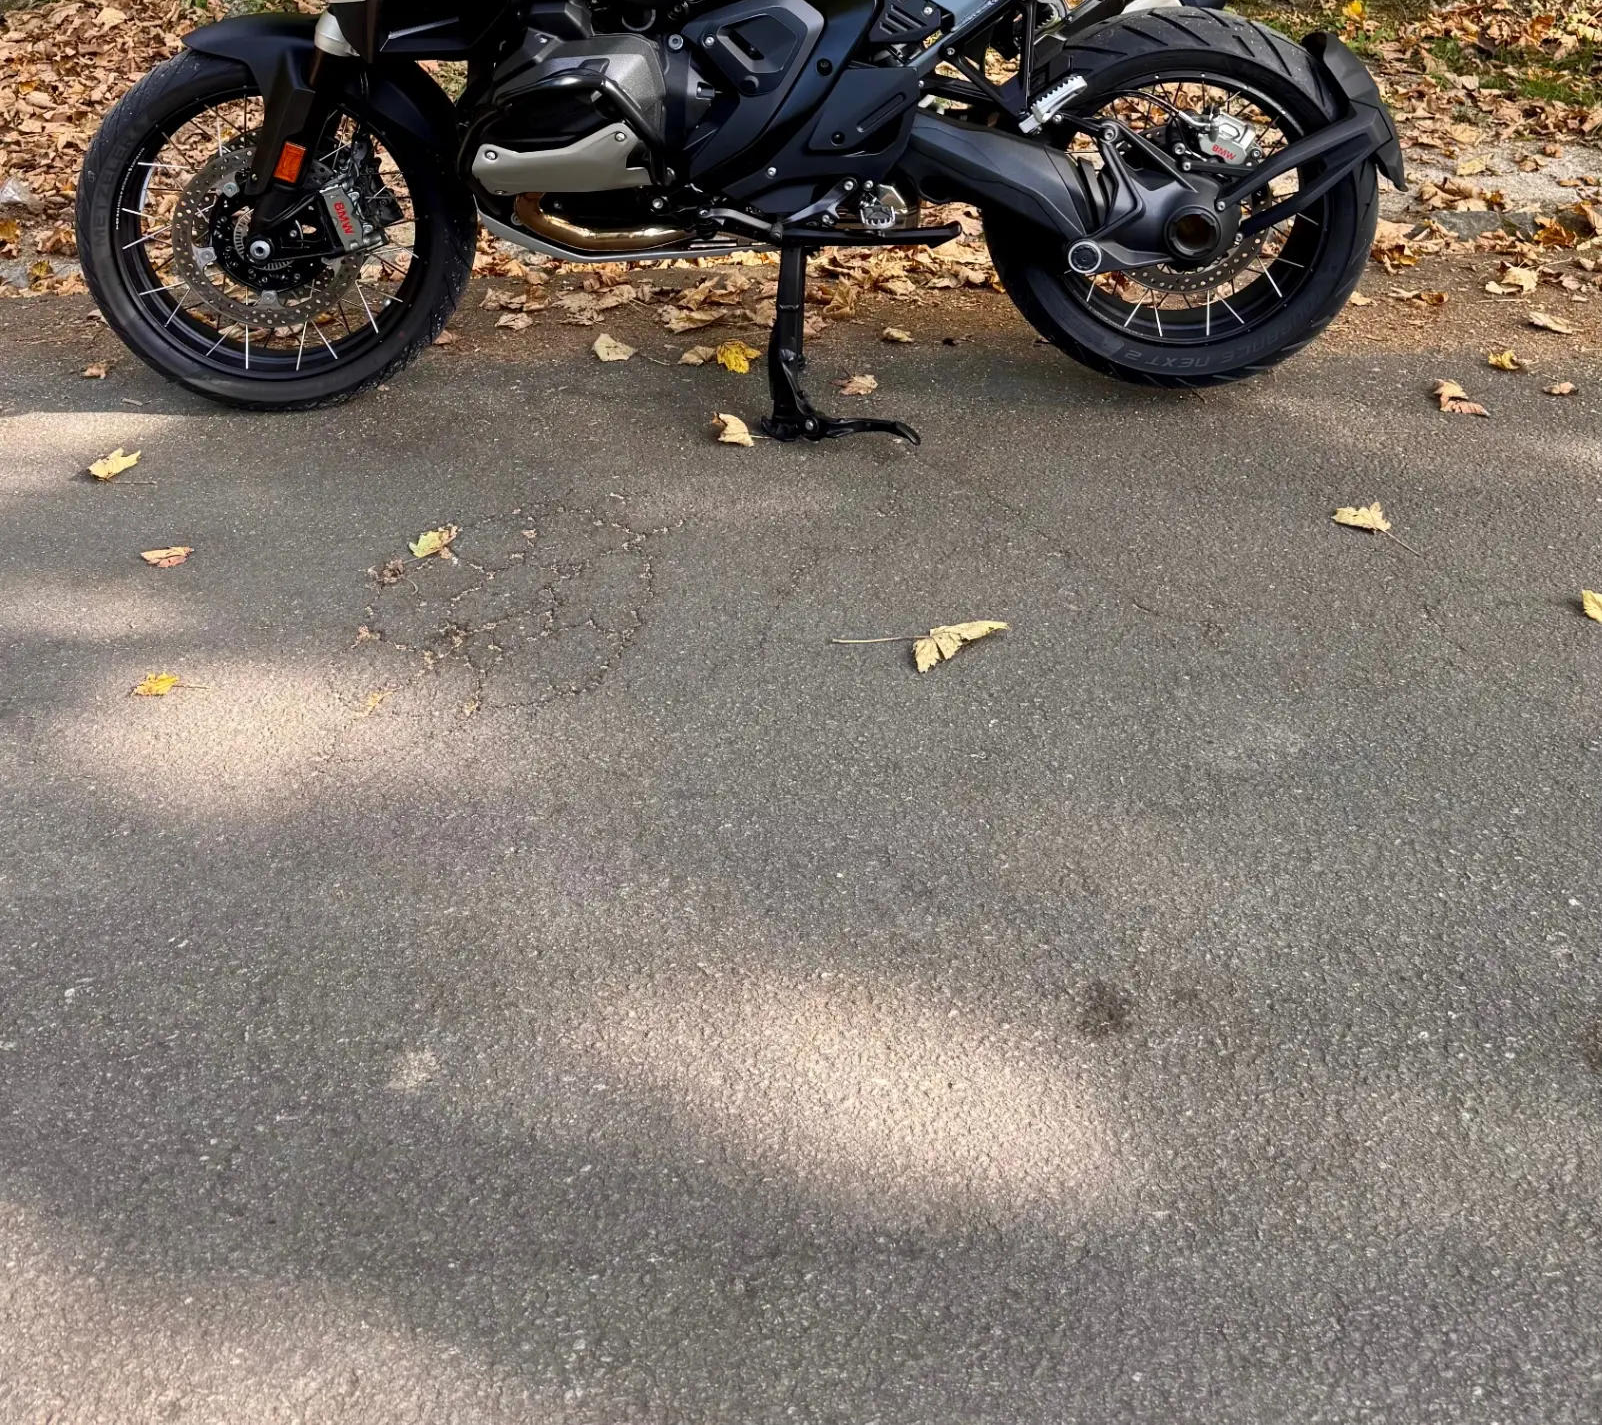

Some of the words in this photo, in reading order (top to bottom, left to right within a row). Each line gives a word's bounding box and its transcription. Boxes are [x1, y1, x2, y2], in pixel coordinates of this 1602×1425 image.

[1211, 144, 1237, 160] BMW
[94, 132, 137, 246] METZELER
[333, 201, 355, 235] BMW
[1123, 348, 1143, 362] 2
[1144, 352, 1212, 369] NEXT
